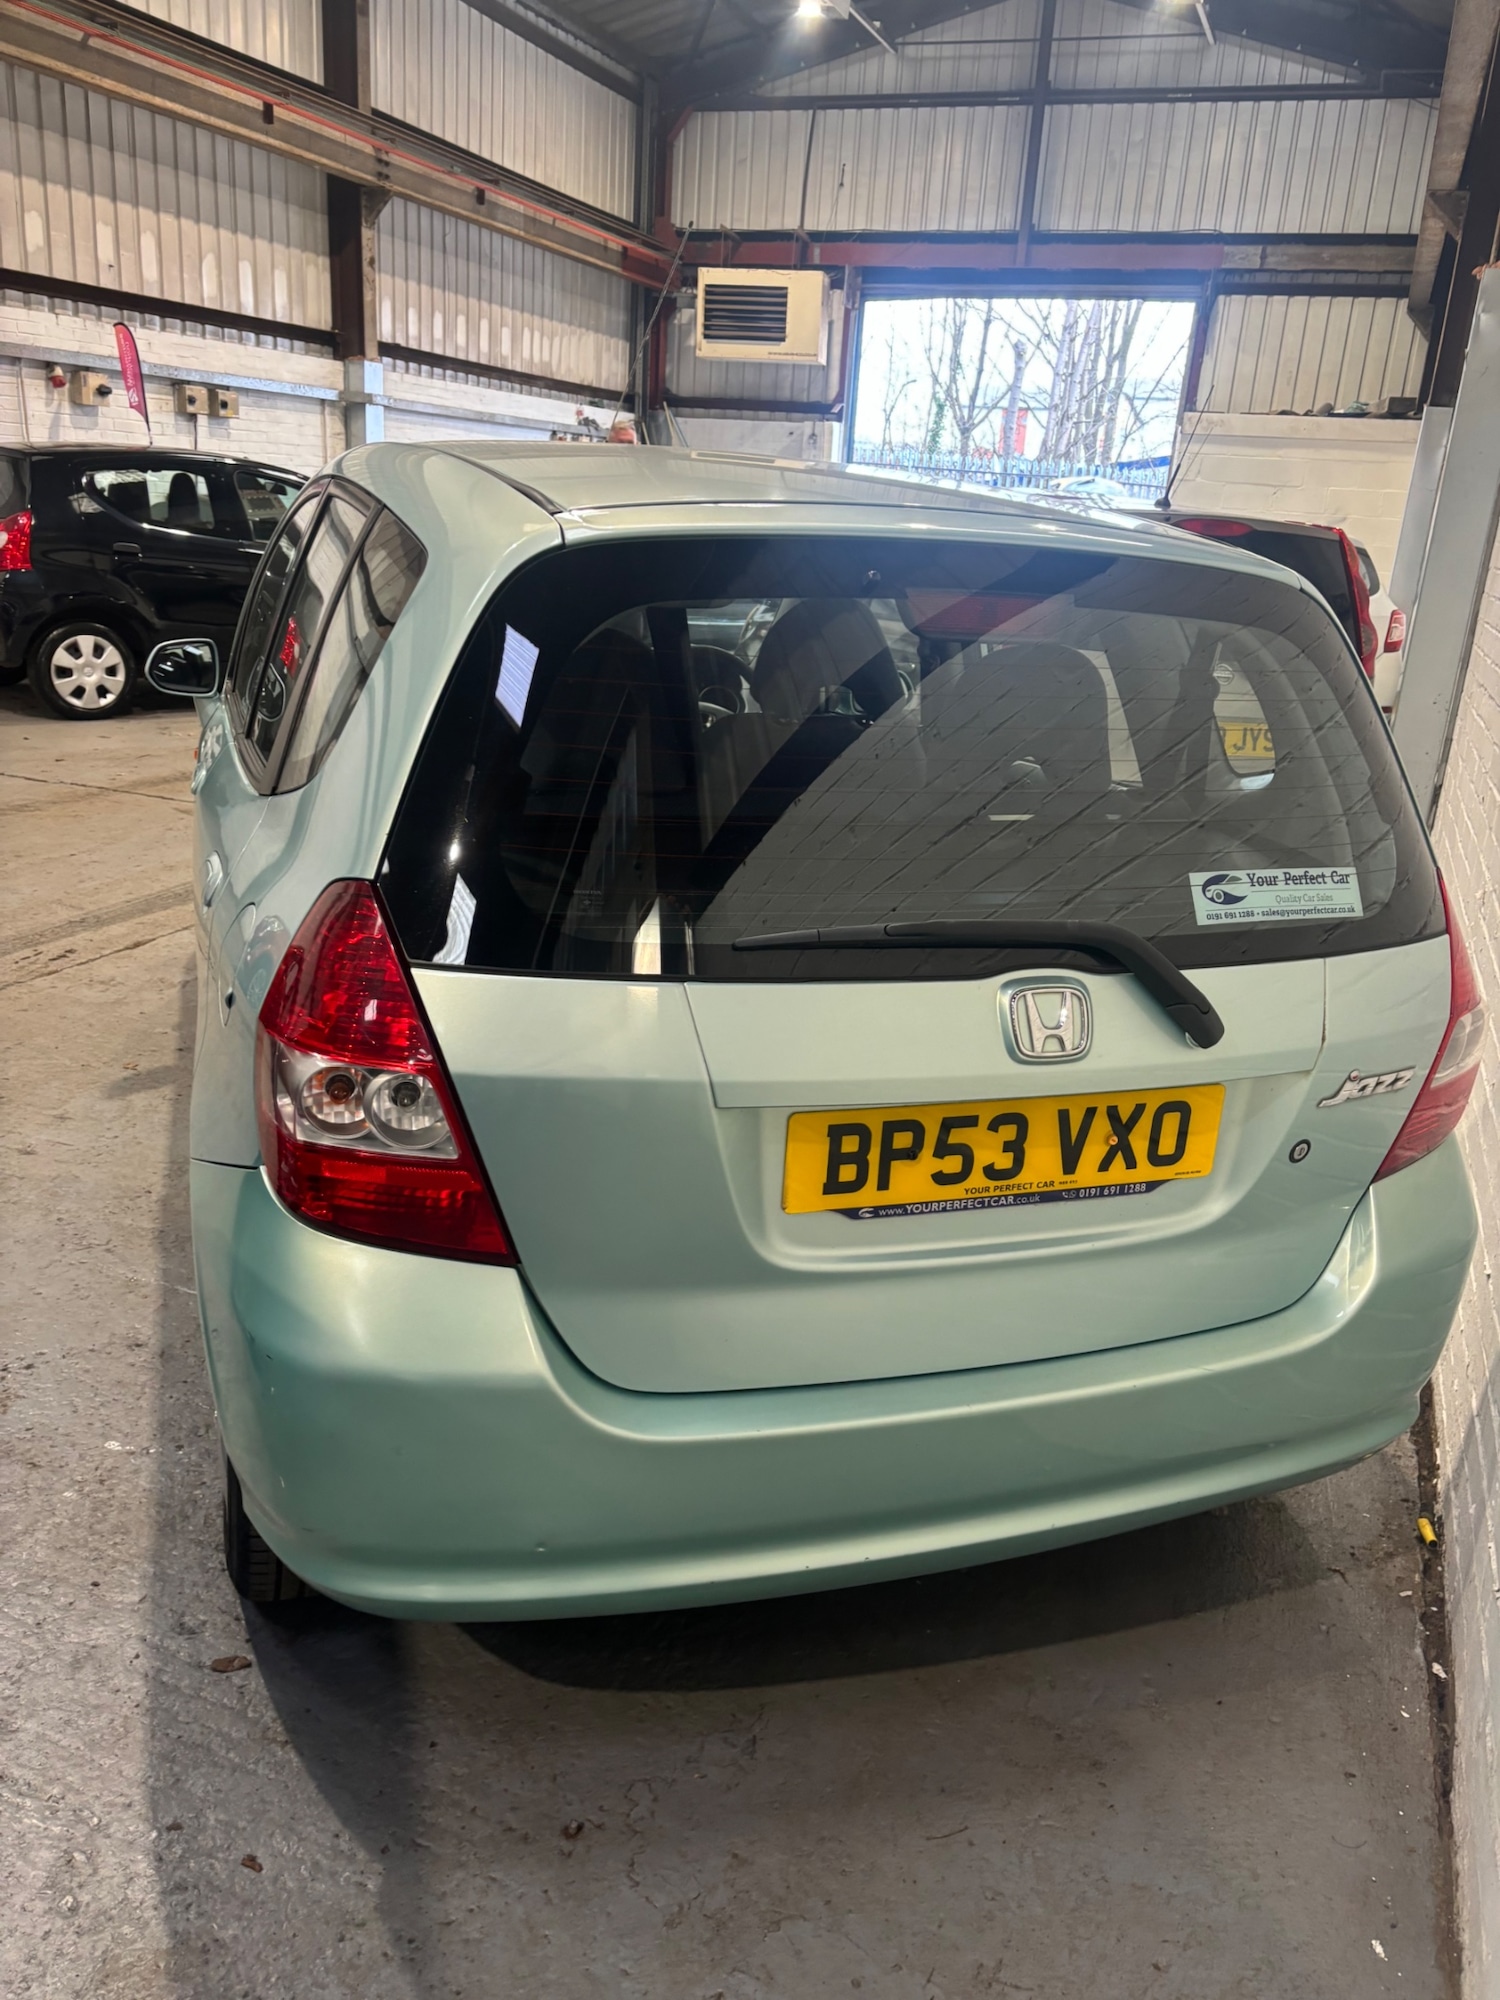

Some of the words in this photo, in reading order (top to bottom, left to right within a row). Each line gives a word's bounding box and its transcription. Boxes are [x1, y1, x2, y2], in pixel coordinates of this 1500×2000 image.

[1246, 872, 1279, 886] Your
[1283, 870, 1327, 886] Perfect
[1330, 870, 1350, 884] Car
[1275, 894, 1302, 904] Quality
[1303, 893, 1315, 902] Car
[1316, 893, 1334, 902] Sales
[1206, 911, 1223, 920] 0191
[1224, 911, 1237, 919] 691
[1239, 910, 1255, 918] 1288
[822, 1112, 1029, 1195] BP53
[1057, 1100, 1192, 1176] VXO
[964, 1185, 990, 1195] YOUR
[993, 1182, 1033, 1193] PERFECT
[1036, 1180, 1055, 1189] CAR
[1079, 1187, 1100, 1198] 0191
[1103, 1185, 1120, 1196] 691
[1124, 1183, 1147, 1193] 1288
[878, 1194, 1042, 1216] www.YOURPERFECTCAR.co.uk
